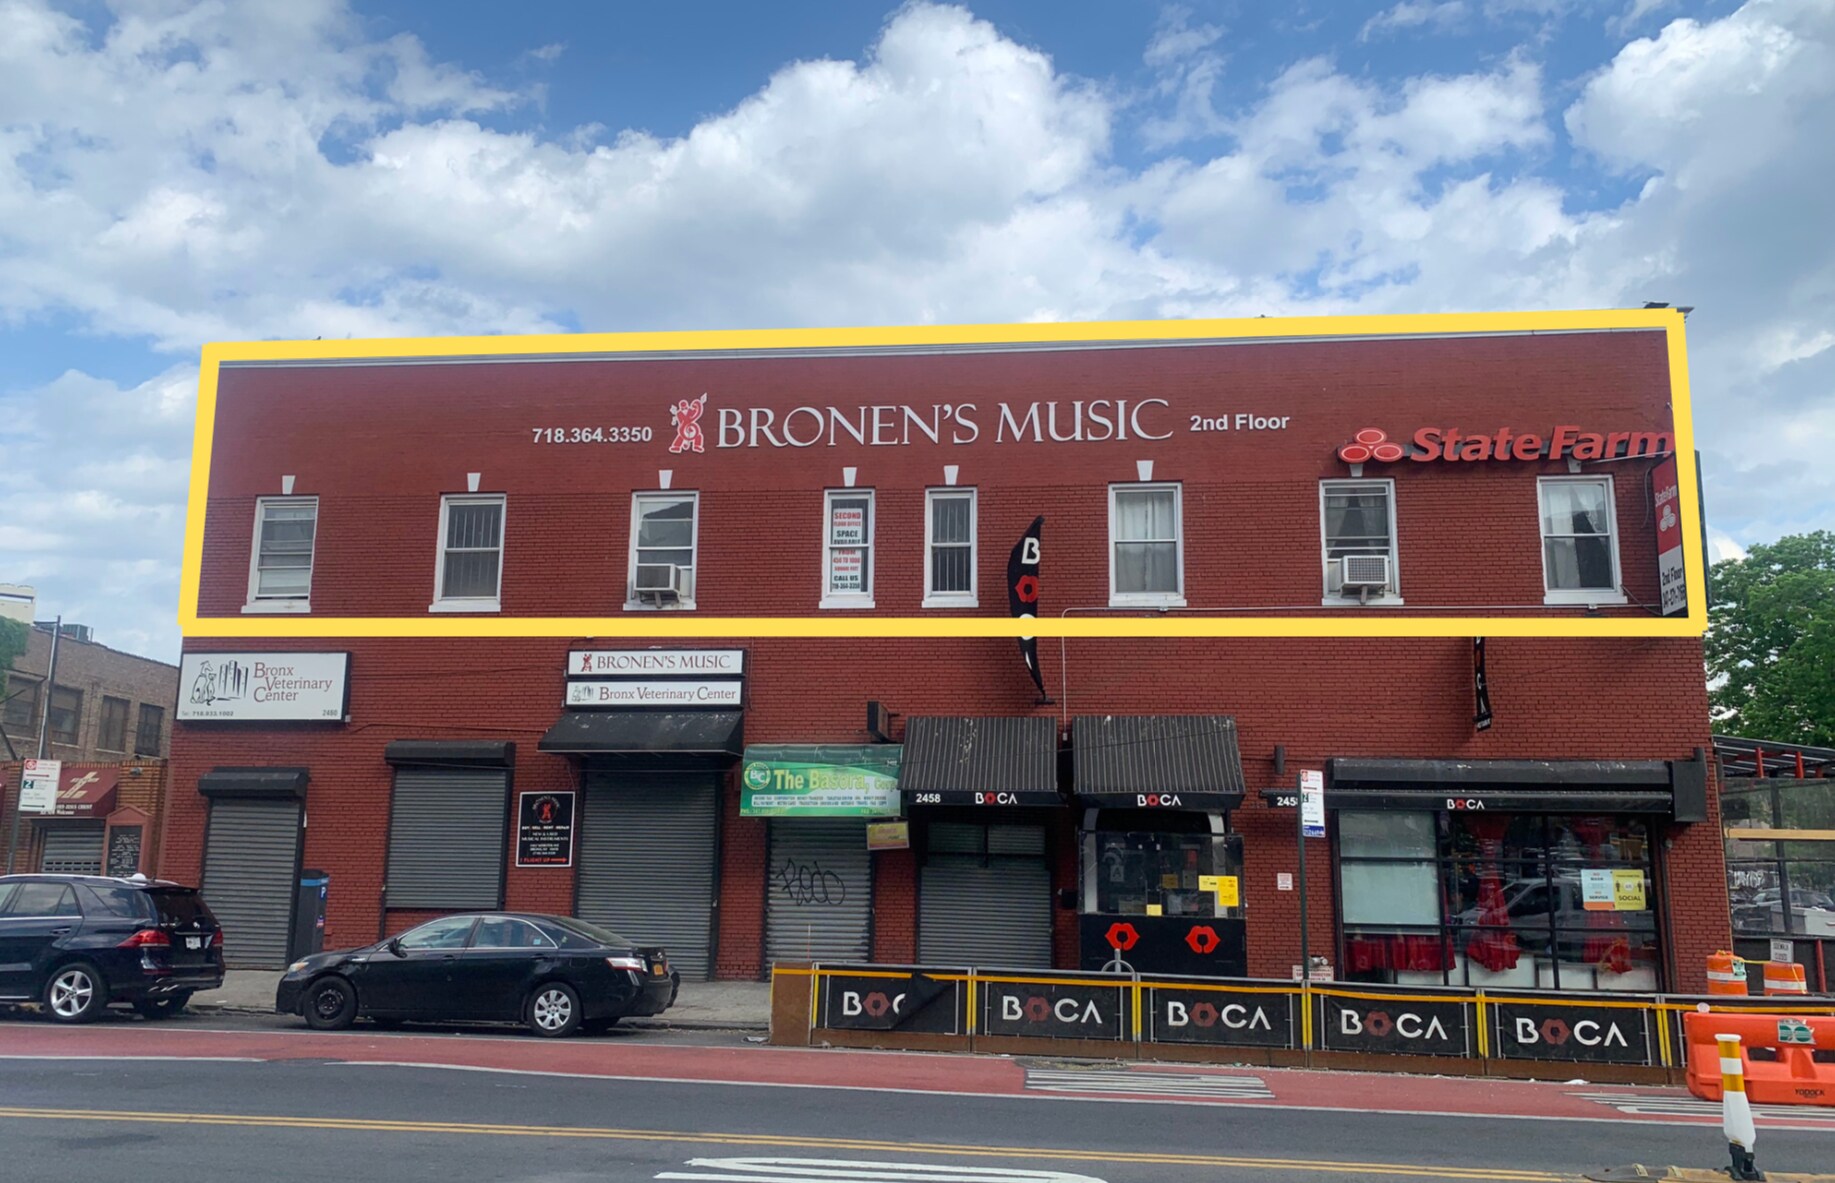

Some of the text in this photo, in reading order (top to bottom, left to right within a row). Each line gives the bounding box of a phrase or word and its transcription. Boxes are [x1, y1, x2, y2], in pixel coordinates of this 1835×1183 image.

[716, 398, 1174, 448] BRONEN'S MUSIC
[1190, 413, 1290, 431] 2nd Floor
[532, 427, 652, 443] 718.364.3350
[253, 662, 294, 678] Bronx
[597, 655, 731, 669] BRONEN'S MUSIC
[265, 676, 332, 692] Veterinary
[253, 687, 299, 703] Center
[599, 686, 737, 701] Bronx Veterinary Center
[774, 769, 804, 790] The
[916, 792, 1018, 805] 2458 BOCA
[1137, 794, 1182, 807] BOCA
[1446, 798, 1485, 810] BOCA
[1002, 995, 1103, 1024] BOCA
[1167, 1001, 1272, 1030] BOCA
[1340, 1008, 1449, 1040] BOCA
[1516, 1017, 1629, 1047] BOCA
